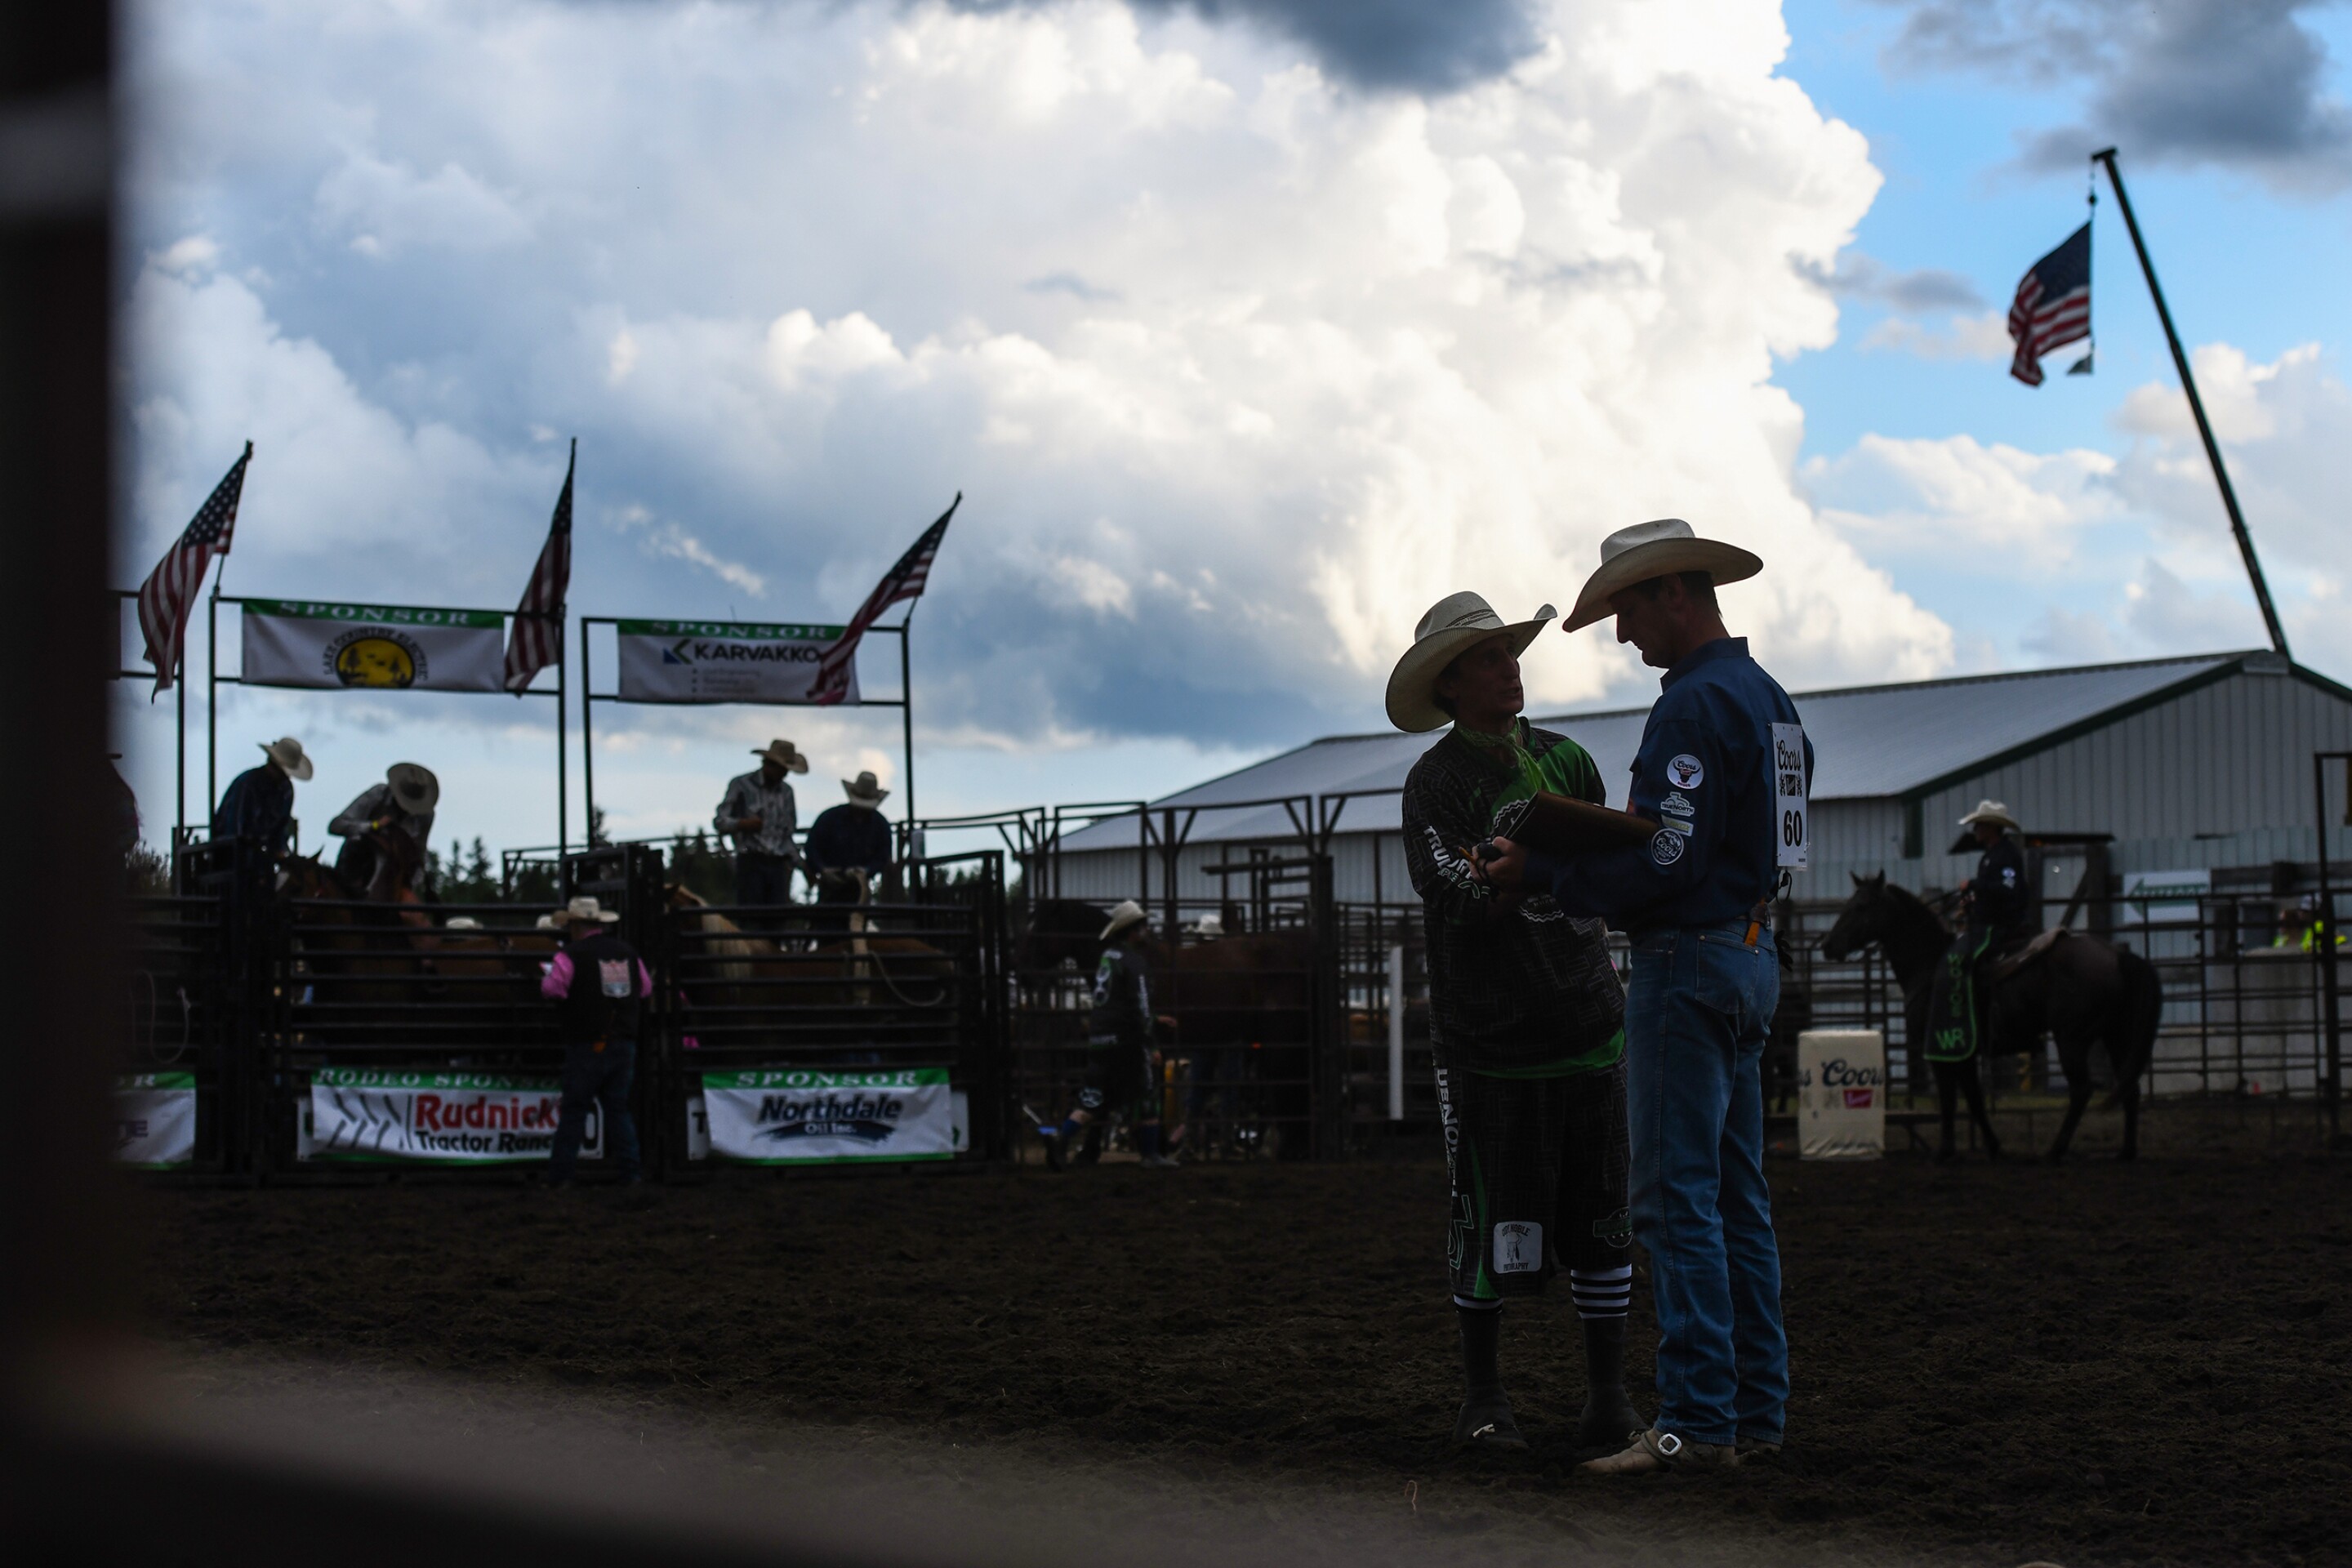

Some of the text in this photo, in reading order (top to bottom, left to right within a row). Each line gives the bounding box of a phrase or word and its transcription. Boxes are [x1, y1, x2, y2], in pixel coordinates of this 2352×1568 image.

[279, 602, 470, 625] SPONSOR
[652, 621, 827, 639] SPONSOR
[694, 644, 820, 663] KARVAKKO
[1776, 739, 1802, 771] Coors
[1784, 809, 1802, 847] 60
[1655, 835, 1677, 857] Coors
[317, 1068, 562, 1089] RODEO SPONSO
[737, 1070, 919, 1087] SPONSOR
[758, 1094, 902, 1125] Northdale
[415, 1131, 553, 1153] Tractor Ranc
